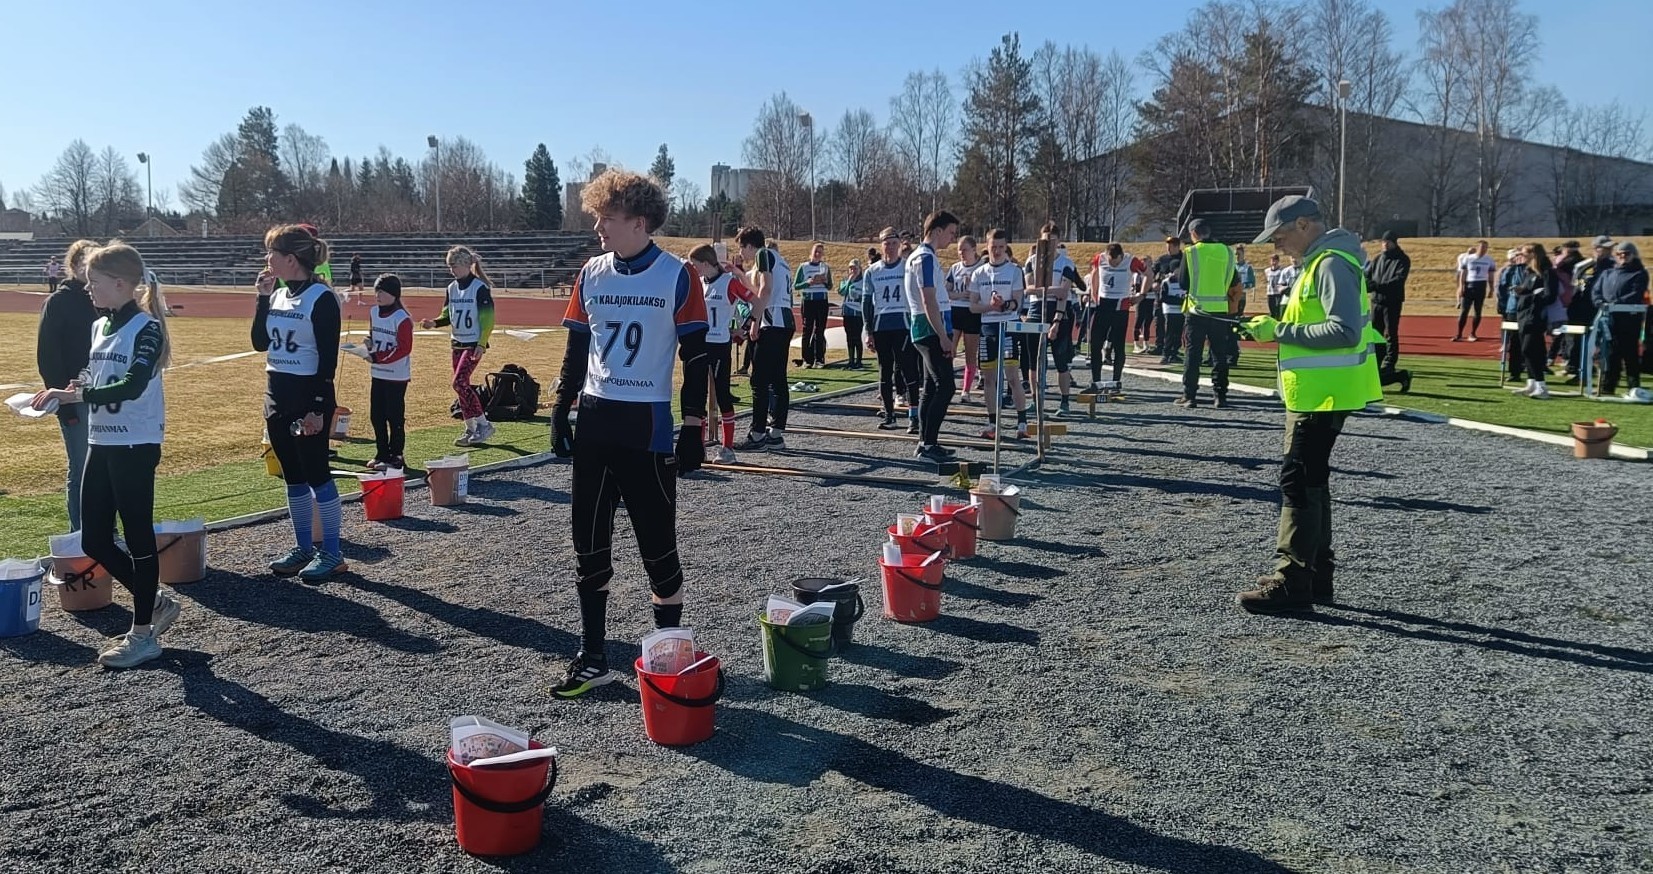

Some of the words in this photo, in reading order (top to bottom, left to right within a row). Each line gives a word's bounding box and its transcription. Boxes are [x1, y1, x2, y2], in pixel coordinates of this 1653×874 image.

[1107, 276, 1115, 289] 4
[600, 295, 666, 308] KALAJOKILAAKSO
[882, 285, 901, 303] 44
[455, 309, 473, 329] 76
[600, 321, 643, 368] 79
